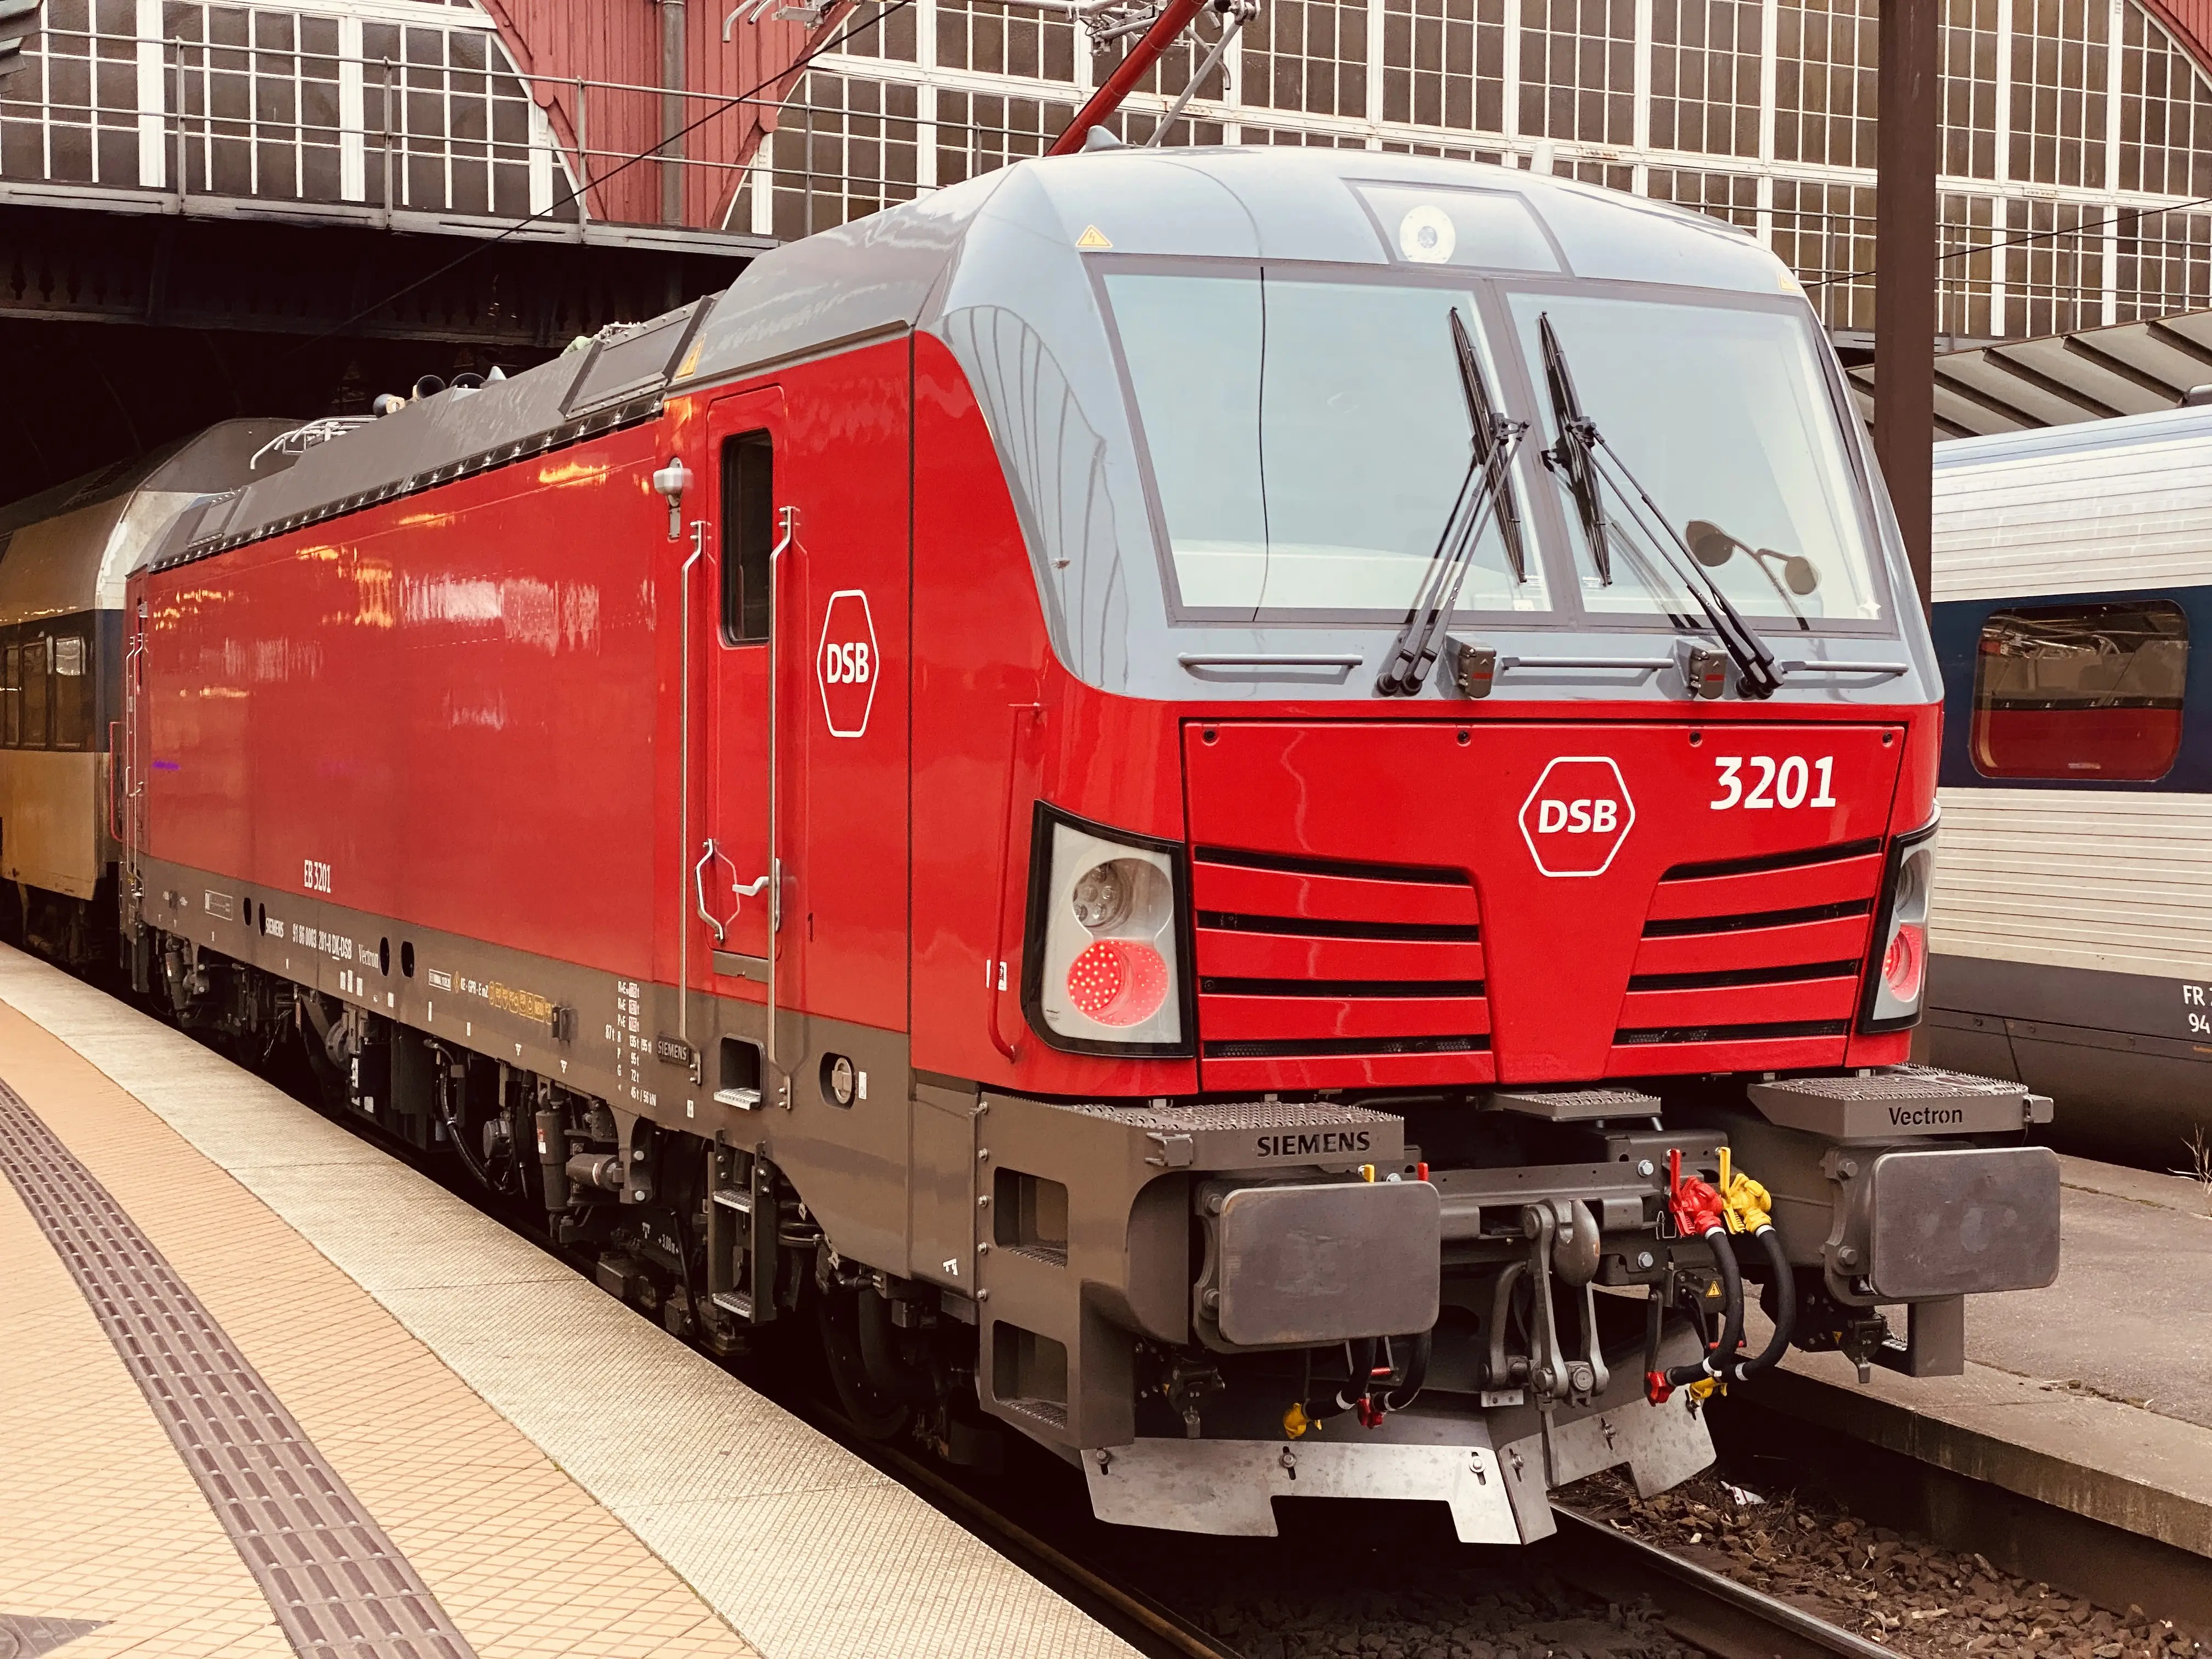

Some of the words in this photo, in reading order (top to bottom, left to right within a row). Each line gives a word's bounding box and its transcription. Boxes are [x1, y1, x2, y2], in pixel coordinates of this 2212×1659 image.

[827, 642, 869, 684] DSB
[1710, 756, 1836, 810] 3201
[1538, 799, 1617, 833] DSB
[304, 859, 313, 888] EB
[314, 861, 331, 894] 3201
[292, 923, 298, 943] 91
[358, 944, 379, 968] Vectron
[2183, 985, 2205, 1006] FR
[2188, 1013, 2210, 1034] 94
[658, 1041, 687, 1060] SIEMENS
[1888, 1107, 1963, 1125] Vectron
[1257, 1131, 1370, 1157] SIEMENS
